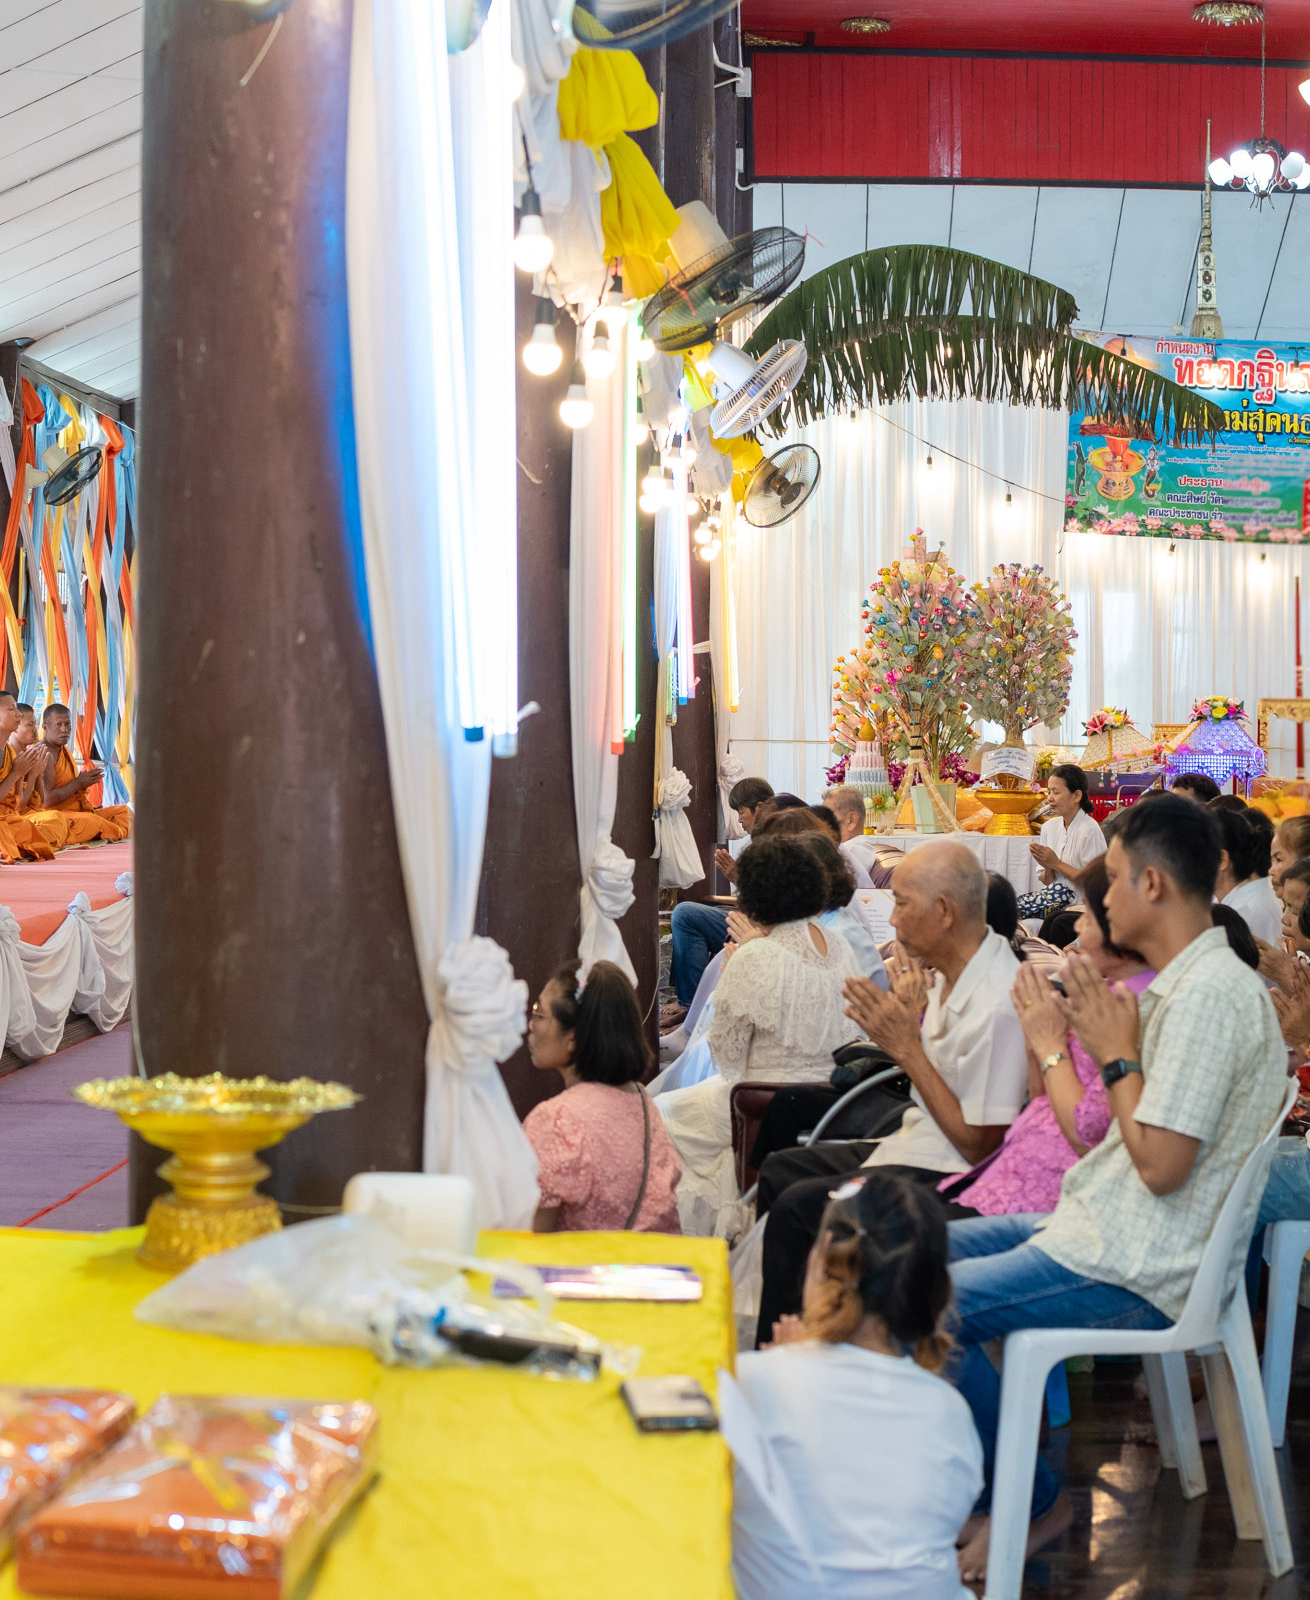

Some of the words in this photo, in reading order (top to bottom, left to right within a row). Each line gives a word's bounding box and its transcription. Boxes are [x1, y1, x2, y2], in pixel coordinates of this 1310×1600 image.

[1156, 337, 1214, 355] กำหนดงาน
[1148, 507, 1209, 520] คณะประชาชน
